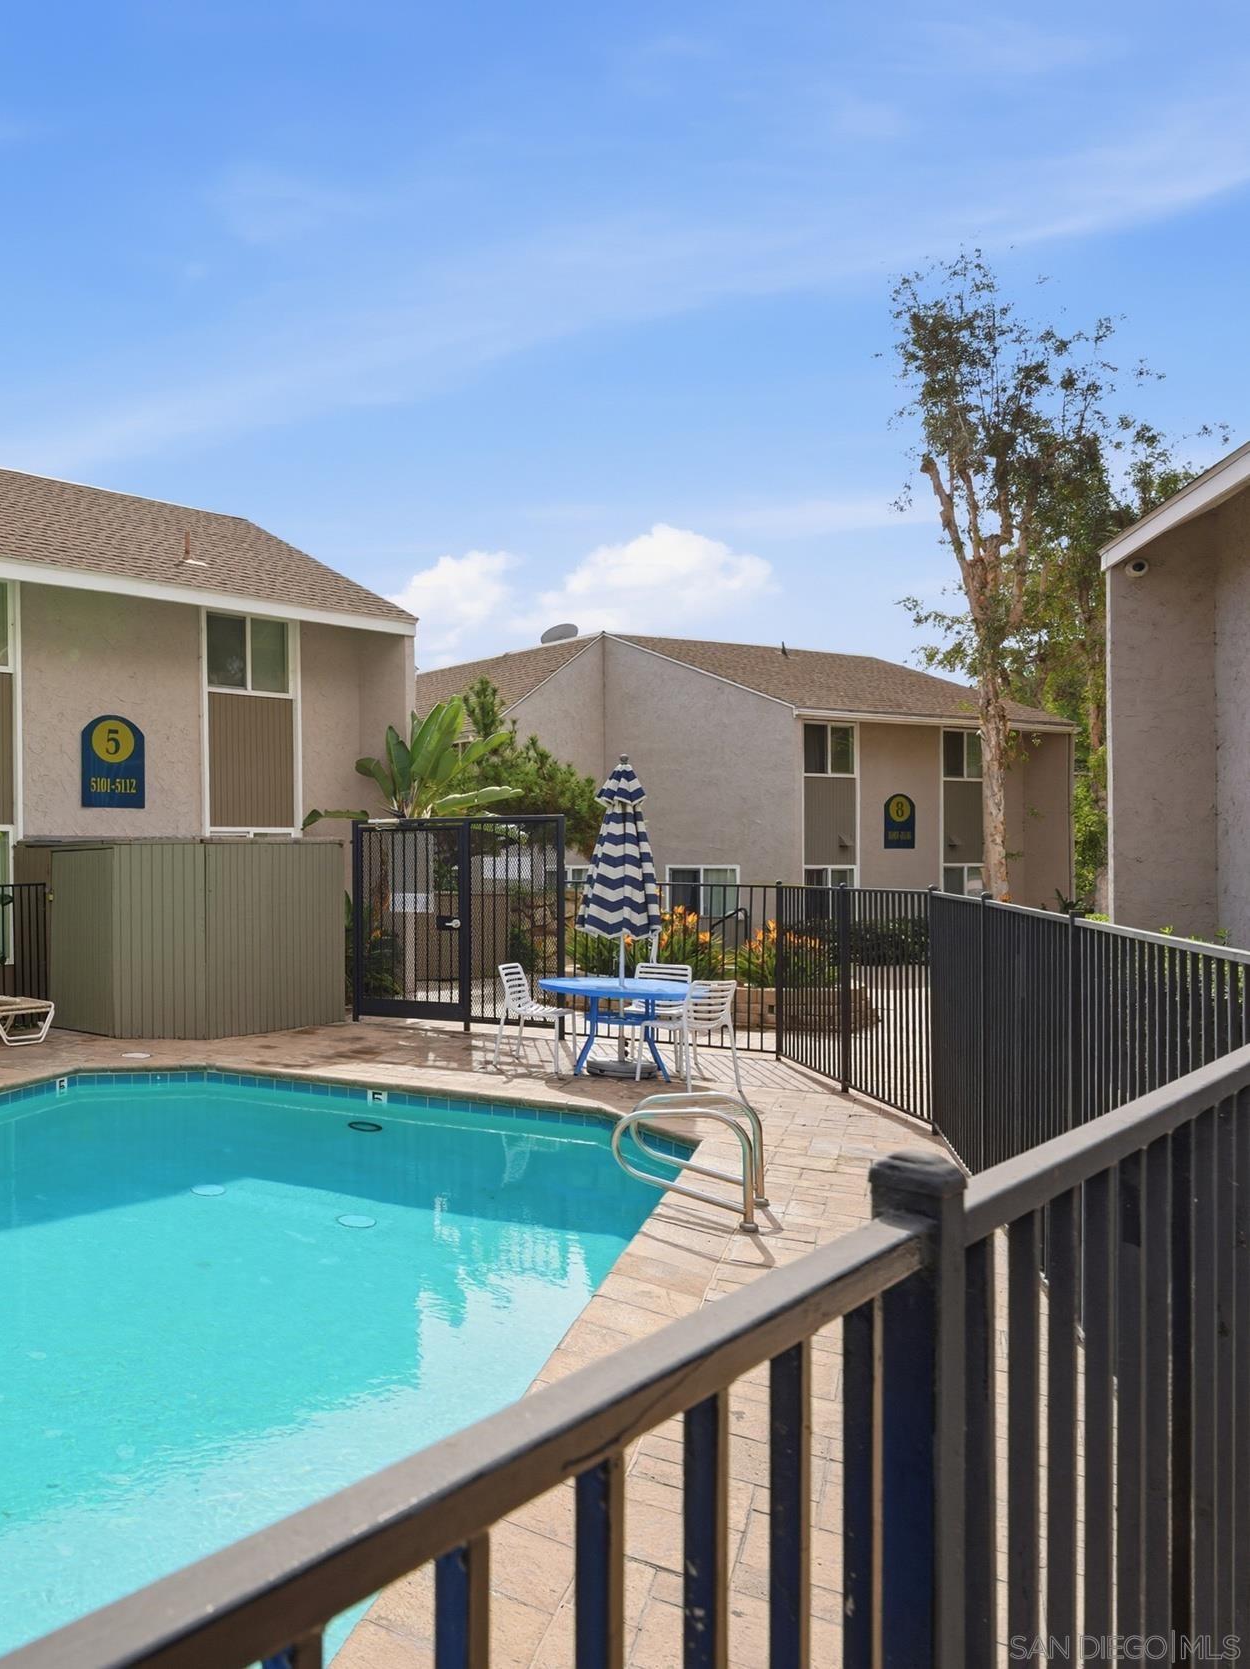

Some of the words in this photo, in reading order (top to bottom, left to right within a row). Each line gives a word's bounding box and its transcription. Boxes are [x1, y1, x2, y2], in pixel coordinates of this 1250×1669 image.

[105, 729, 121, 755] 5
[91, 777, 137, 794] 5101-5112
[896, 801, 904, 818] 8
